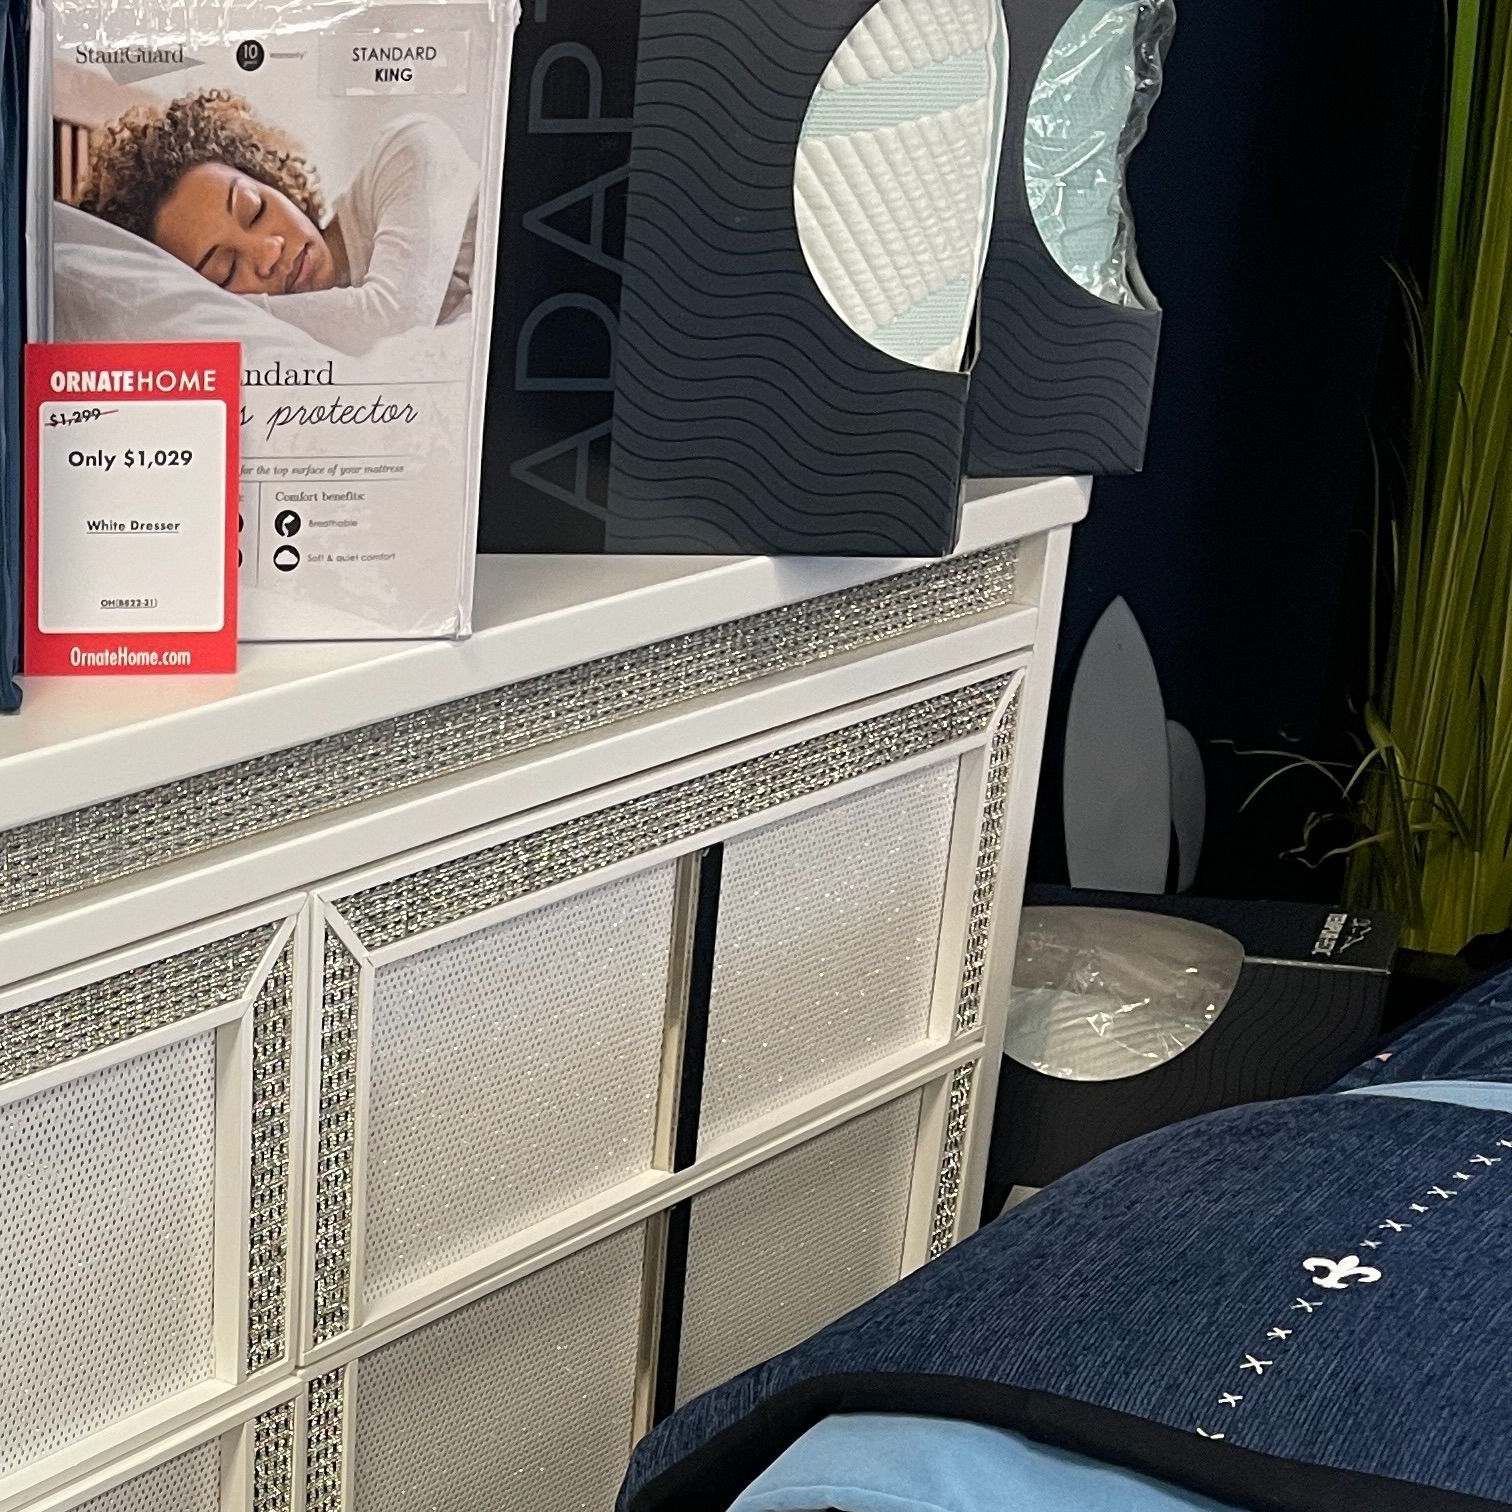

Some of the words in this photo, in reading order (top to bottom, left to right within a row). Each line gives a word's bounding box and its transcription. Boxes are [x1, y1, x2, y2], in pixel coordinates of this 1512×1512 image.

[243, 44, 258, 59] 10
[352, 46, 437, 62] STANDARD
[375, 68, 413, 82] KING
[510, 0, 634, 521] ADAP
[243, 361, 335, 387] ndard
[48, 408, 103, 427] $1,299
[266, 395, 419, 441] protector
[68, 449, 116, 471] Only
[124, 448, 193, 469] $1,029
[257, 465, 270, 475] the
[273, 466, 288, 476] top
[291, 465, 324, 476] surface
[327, 464, 337, 476] of
[340, 466, 362, 476] your
[364, 465, 404, 474] mattress
[275, 491, 318, 502] Comfort
[87, 520, 126, 531] White
[130, 520, 180, 532] Dresser
[308, 519, 358, 528] Breathable
[326, 553, 334, 562] &
[70, 646, 191, 667] OrnateHome.com
